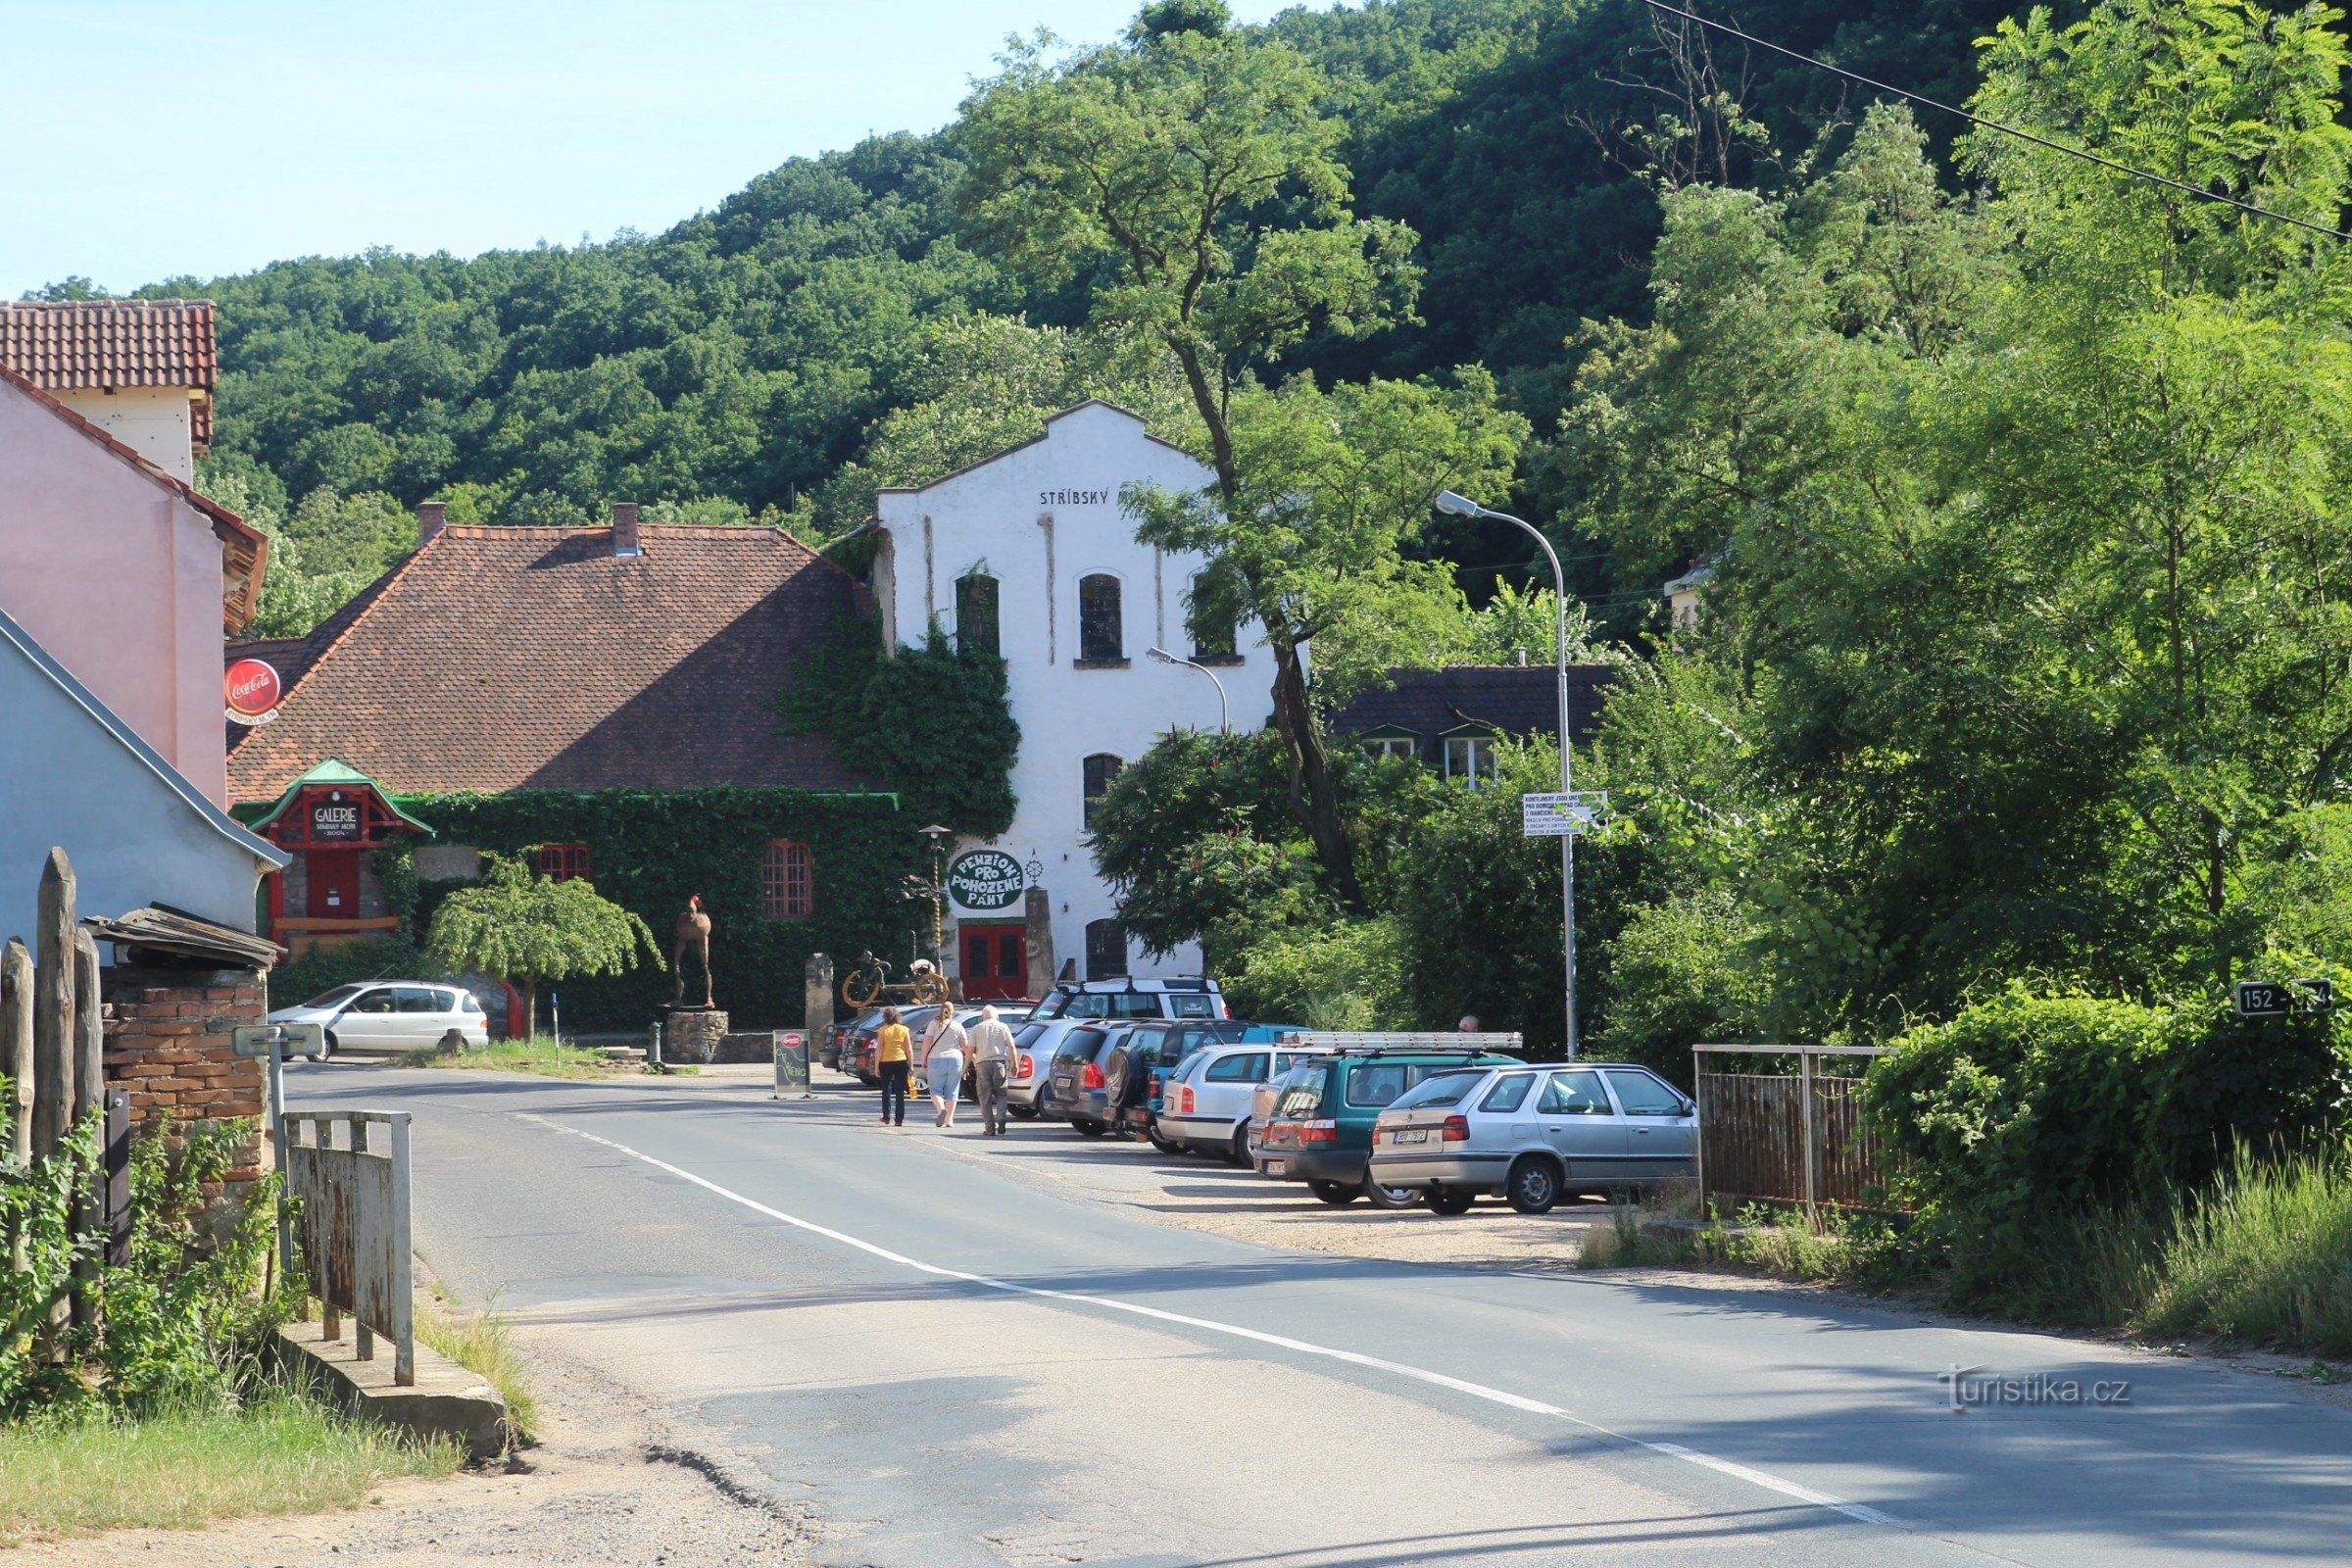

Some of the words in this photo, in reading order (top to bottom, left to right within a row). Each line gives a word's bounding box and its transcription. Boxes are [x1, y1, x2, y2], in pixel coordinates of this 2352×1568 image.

[1040, 487, 1108, 505] STŘÍBSKÝ
[315, 808, 357, 822] GALERIE
[975, 866, 1000, 880] PRO
[951, 872, 1021, 894] POHOZENÉ
[966, 893, 1005, 906] PÁNY
[2244, 990, 2273, 1008] 152
